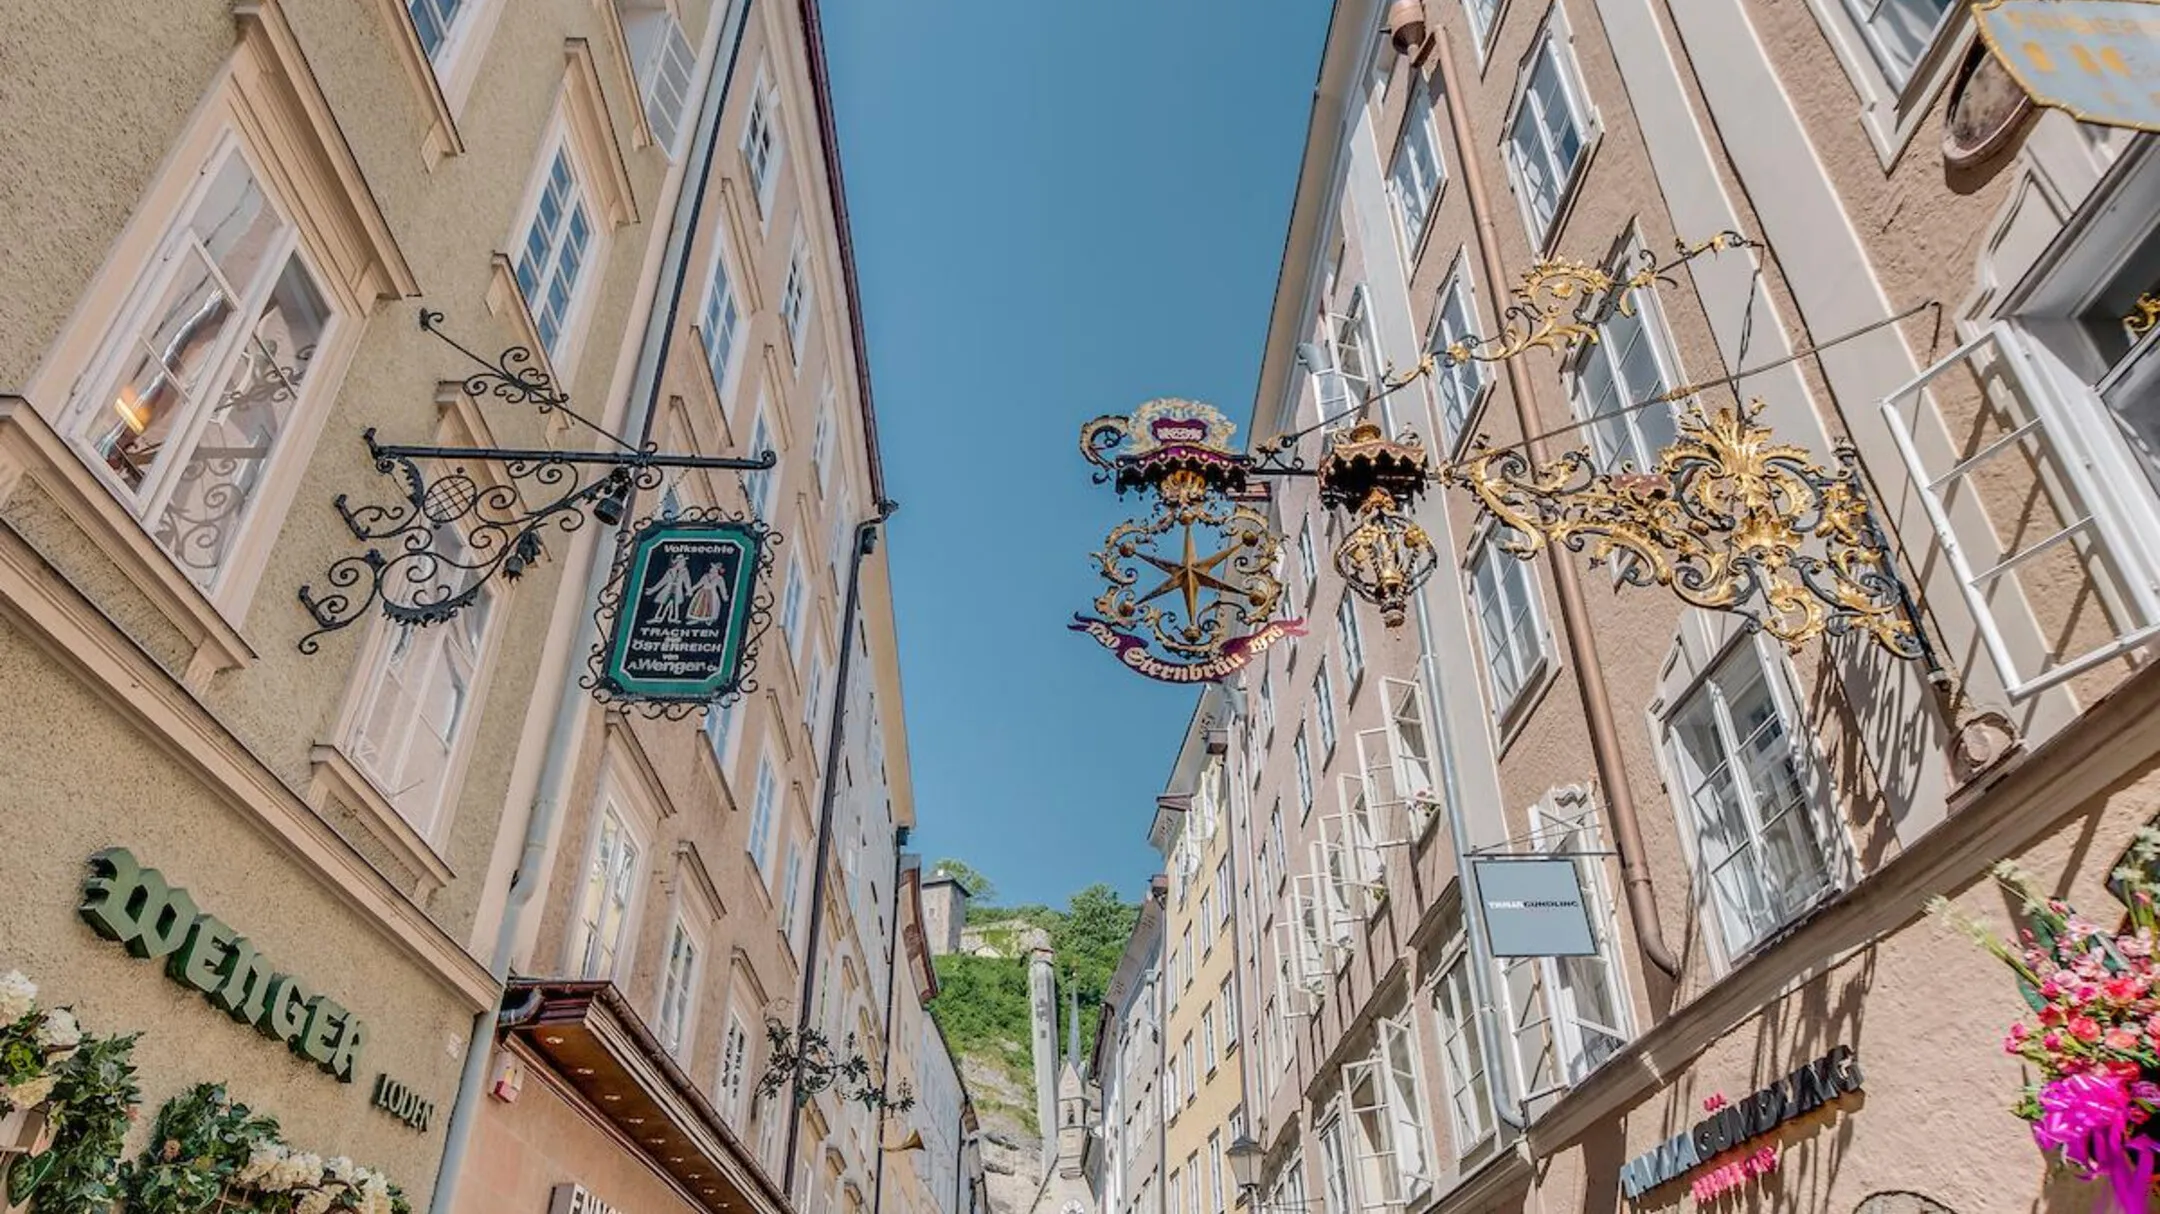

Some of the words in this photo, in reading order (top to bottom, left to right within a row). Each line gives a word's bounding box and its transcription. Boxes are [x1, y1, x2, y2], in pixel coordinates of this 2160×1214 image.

[664, 543, 735, 554] Volksechte
[640, 627, 719, 638] TRACHTEN
[631, 639, 722, 652] ÖSTERREICH
[1123, 647, 1244, 682] Sternbräu
[78, 847, 370, 1083] WENGER
[371, 1073, 435, 1132] LODEN
